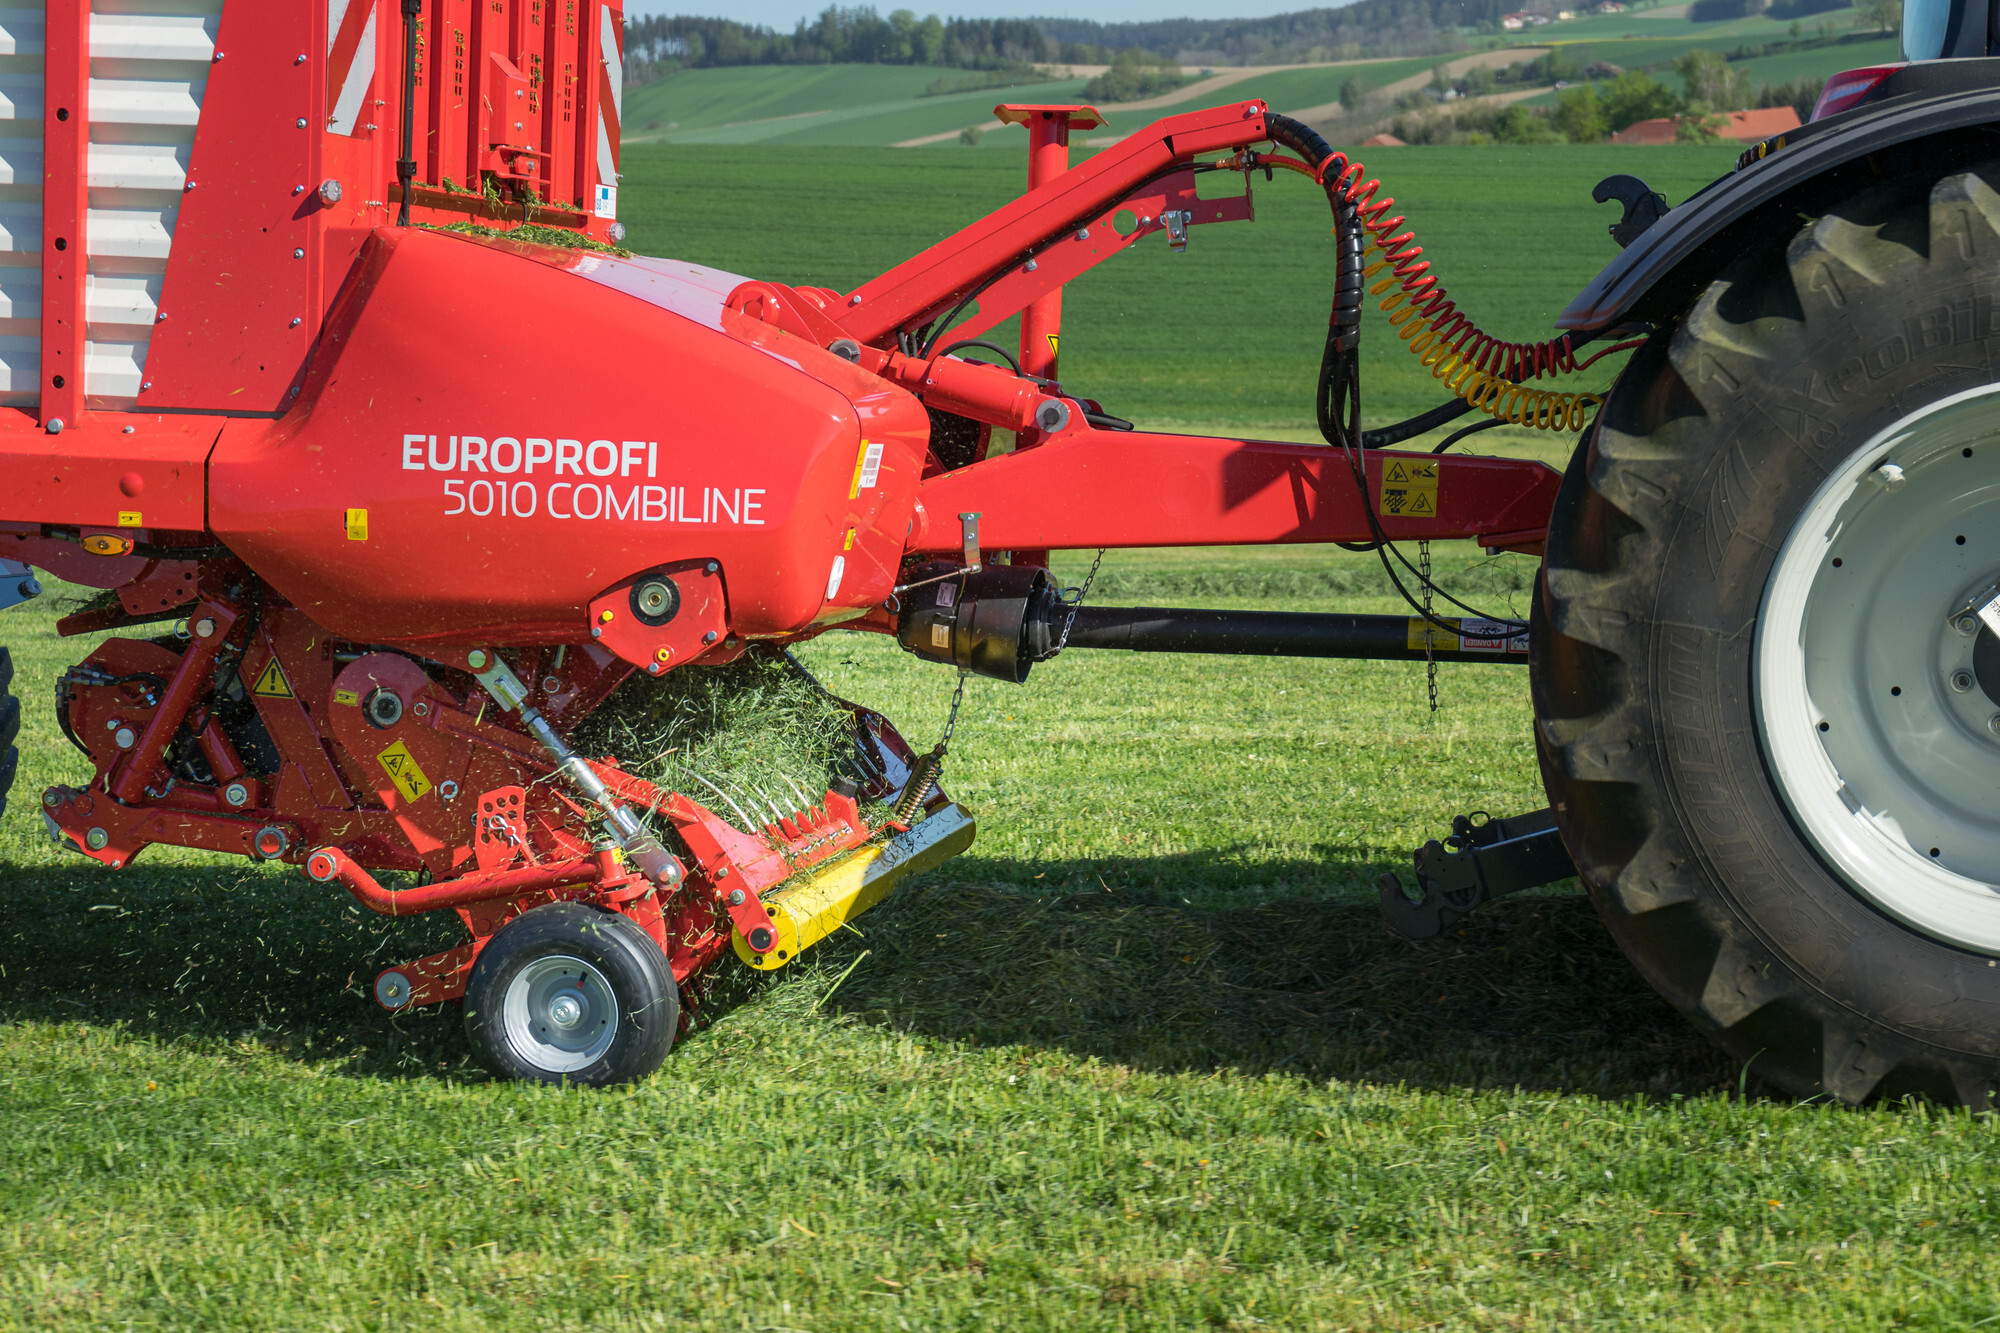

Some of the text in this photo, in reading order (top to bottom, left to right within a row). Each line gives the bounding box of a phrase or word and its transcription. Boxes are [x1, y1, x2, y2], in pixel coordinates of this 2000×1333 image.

[402, 434, 658, 477] EUROPROFI
[443, 479, 766, 525] 5010 COMBILINE
[1464, 639, 1492, 648] DANGER
[1667, 630, 1791, 909] MICHELIN
